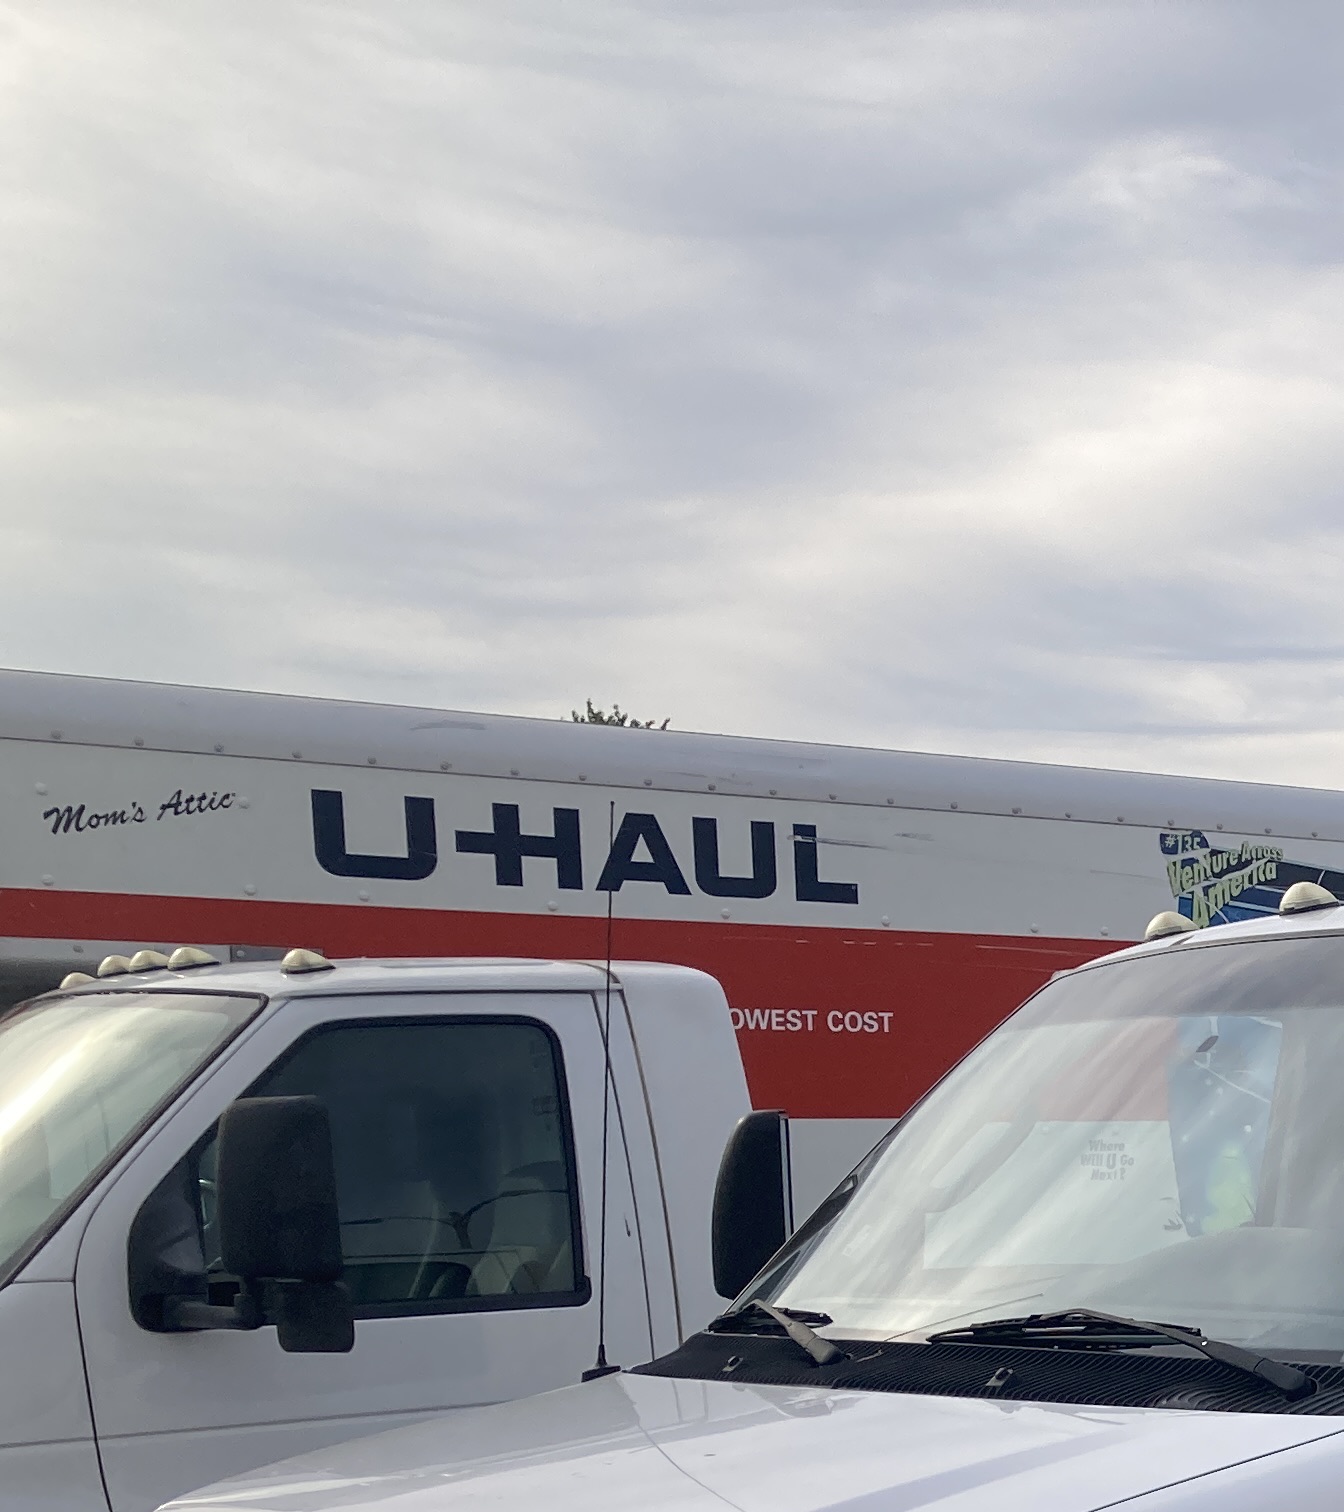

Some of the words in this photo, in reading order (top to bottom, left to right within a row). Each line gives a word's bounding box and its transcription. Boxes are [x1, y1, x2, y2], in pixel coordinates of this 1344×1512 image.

[43, 801, 147, 835] Mom's
[157, 788, 232, 821] Attic
[310, 788, 860, 906] U-HAUL
[729, 1007, 818, 1032] OWEST
[826, 1009, 894, 1033] COST
[1106, 1153, 1117, 1170] U
[1120, 1154, 1135, 1166] Go
